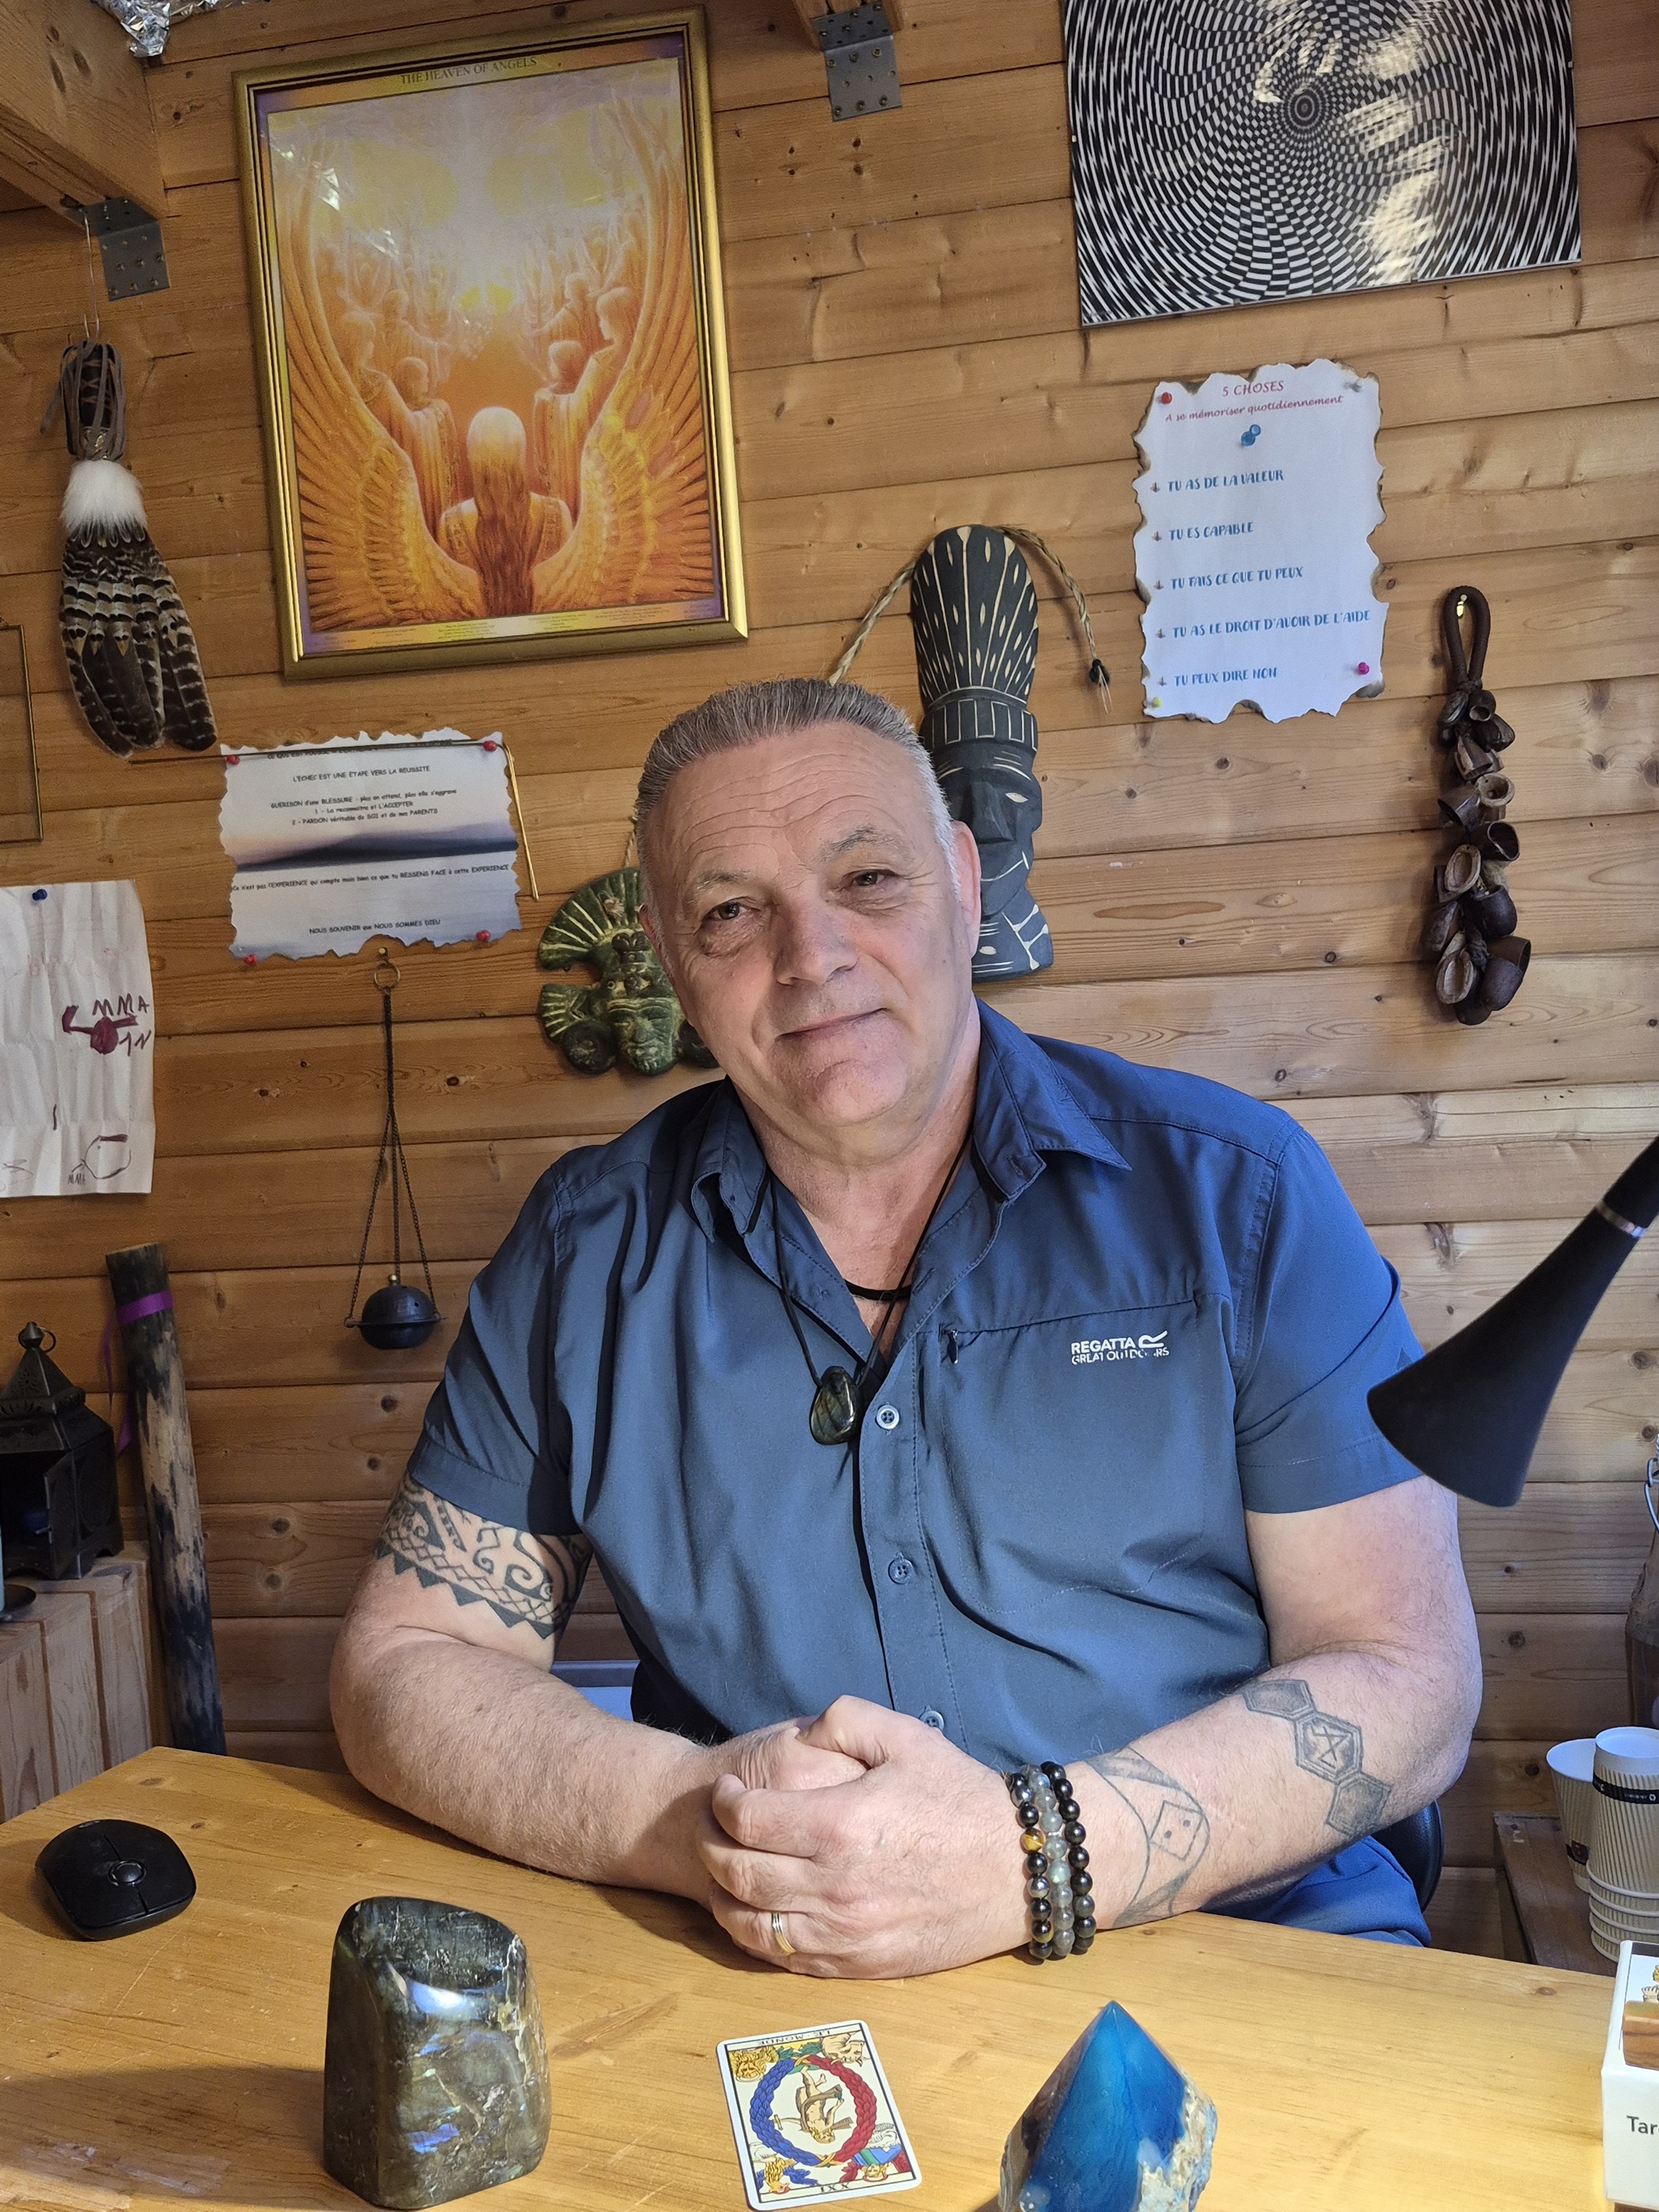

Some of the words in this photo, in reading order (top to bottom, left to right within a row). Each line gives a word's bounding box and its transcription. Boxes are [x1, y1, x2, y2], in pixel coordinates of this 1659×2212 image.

[401, 73, 423, 85] THE
[425, 66, 471, 81] HEAVEN
[474, 63, 489, 73] OF
[492, 57, 537, 70] ANGELS
[1222, 386, 1228, 397] 5
[1233, 380, 1284, 396] CHOSES
[1189, 406, 1245, 419] mémoriser
[1247, 395, 1344, 415] quotidiennement
[1168, 480, 1182, 492] TU
[1185, 479, 1200, 490] AS
[1204, 476, 1219, 489] DE
[1224, 475, 1238, 487] LA
[1241, 469, 1285, 485] VALEUR
[1168, 529, 1183, 541] TU
[1187, 527, 1200, 539] ES
[1203, 521, 1255, 538] CAPABLE
[1171, 577, 1185, 590] TU
[1188, 574, 1212, 587] FAIS
[1215, 573, 1229, 585] CE
[1232, 570, 1254, 583] QUE
[1257, 569, 1272, 582] TU
[1275, 566, 1304, 579] PEUX
[1172, 626, 1187, 638] TU
[1190, 624, 1206, 636] AS
[1209, 623, 1222, 634] LE
[1225, 619, 1262, 634] DROIT
[1263, 615, 1311, 631] D'AVOIR
[1314, 614, 1330, 626] DE
[1333, 610, 1371, 624] L'AIDE
[1174, 675, 1189, 687] TU
[1191, 672, 1219, 685] PEUX
[1222, 669, 1250, 682] DIRE
[1252, 667, 1277, 679] NON
[322, 796, 353, 805] BLESSURE
[329, 924, 361, 933] SOUVENIR
[395, 920, 423, 928] SOMMES
[1071, 1337, 1136, 1355] REGATTA
[758, 2034, 803, 2045] MONDE
[1627, 2114, 1659, 2135] Tar
[820, 2181, 849, 2193] XXI
